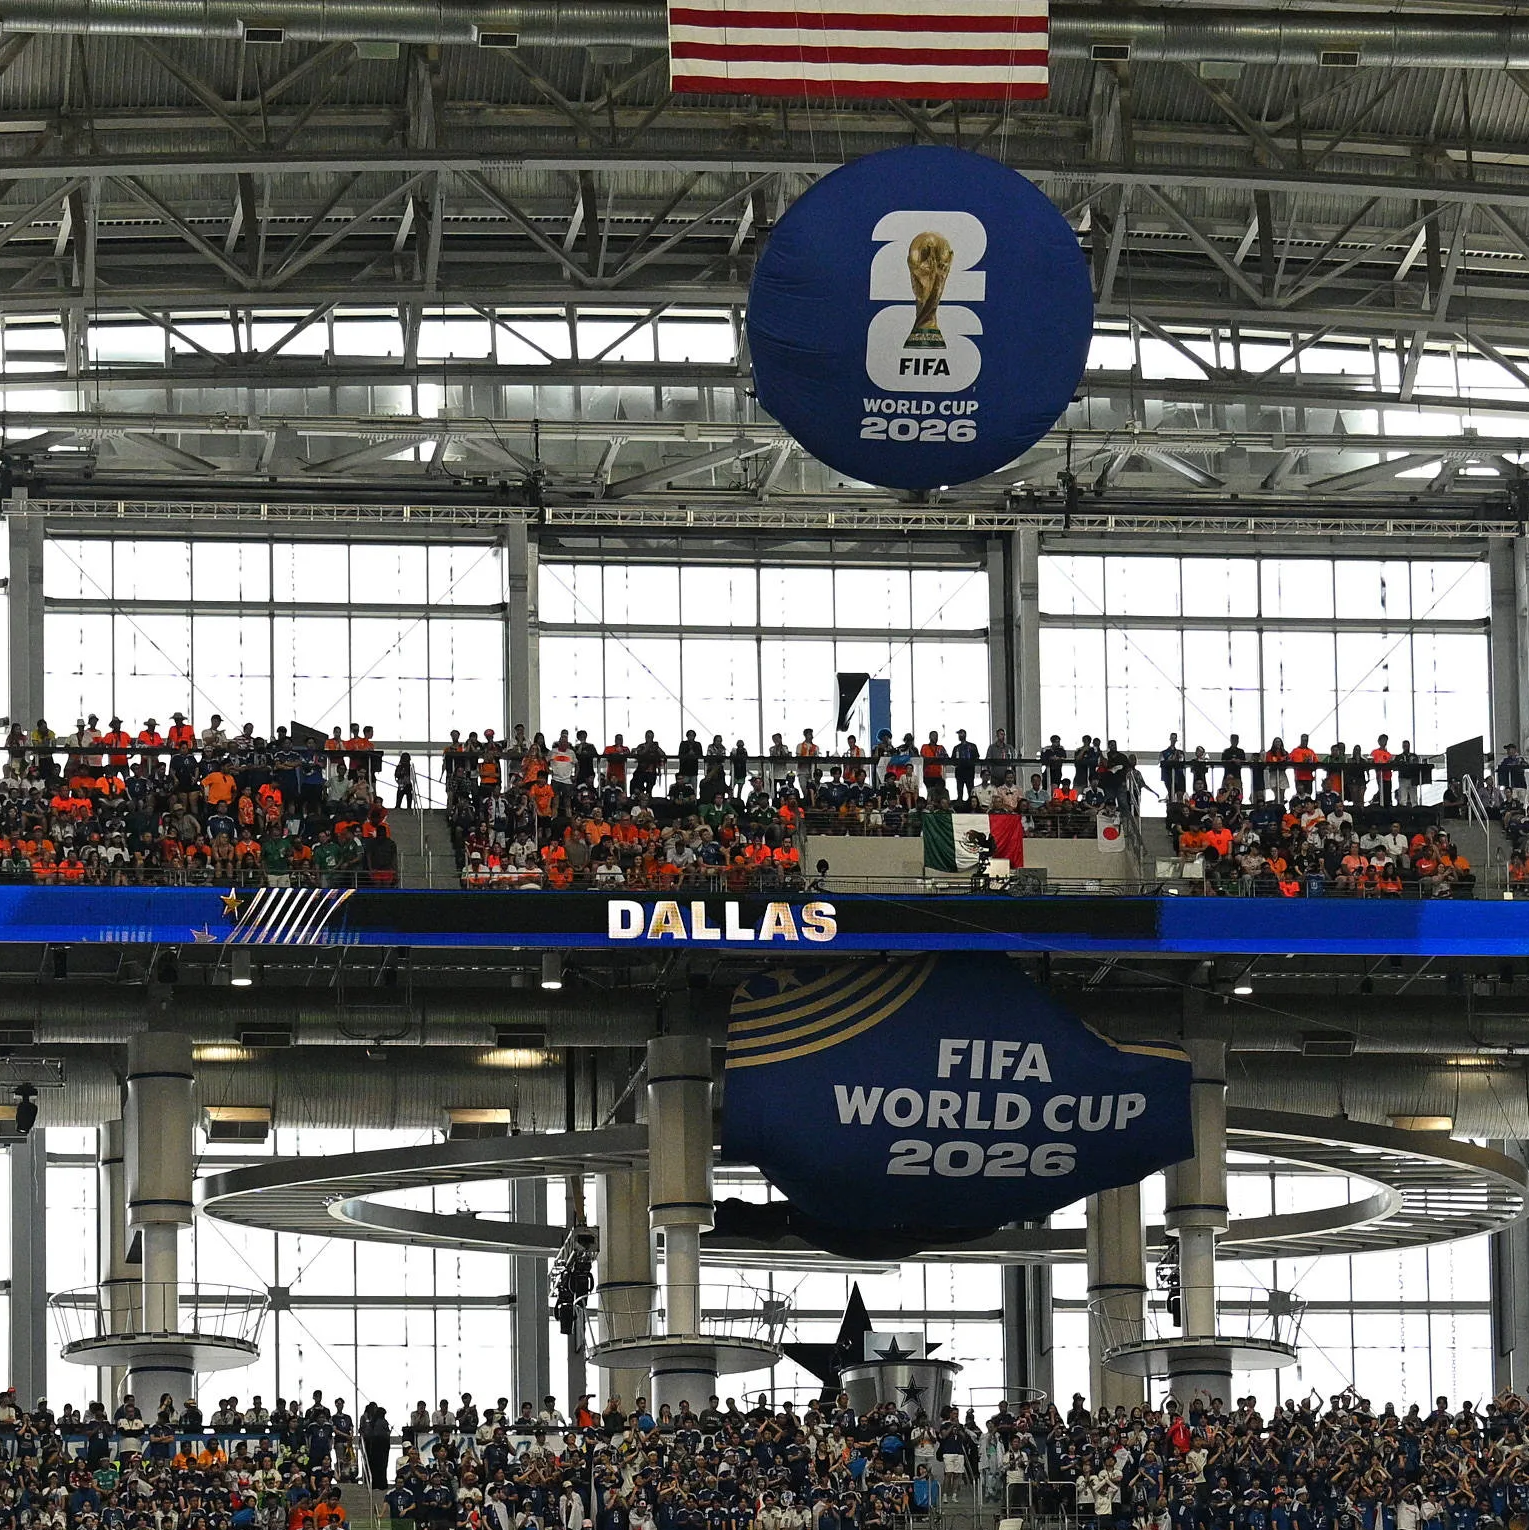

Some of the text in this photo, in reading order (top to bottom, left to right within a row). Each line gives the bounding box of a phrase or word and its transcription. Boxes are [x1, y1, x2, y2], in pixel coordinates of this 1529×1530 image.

[898, 357, 950, 377] FIFA
[863, 398, 979, 417] WORLD CUP
[860, 418, 977, 443] 2026
[607, 900, 838, 941] DALLAS
[937, 1037, 1053, 1084] FIFA
[833, 1084, 1147, 1132] WORLD CUP
[885, 1139, 1078, 1179] 2026
